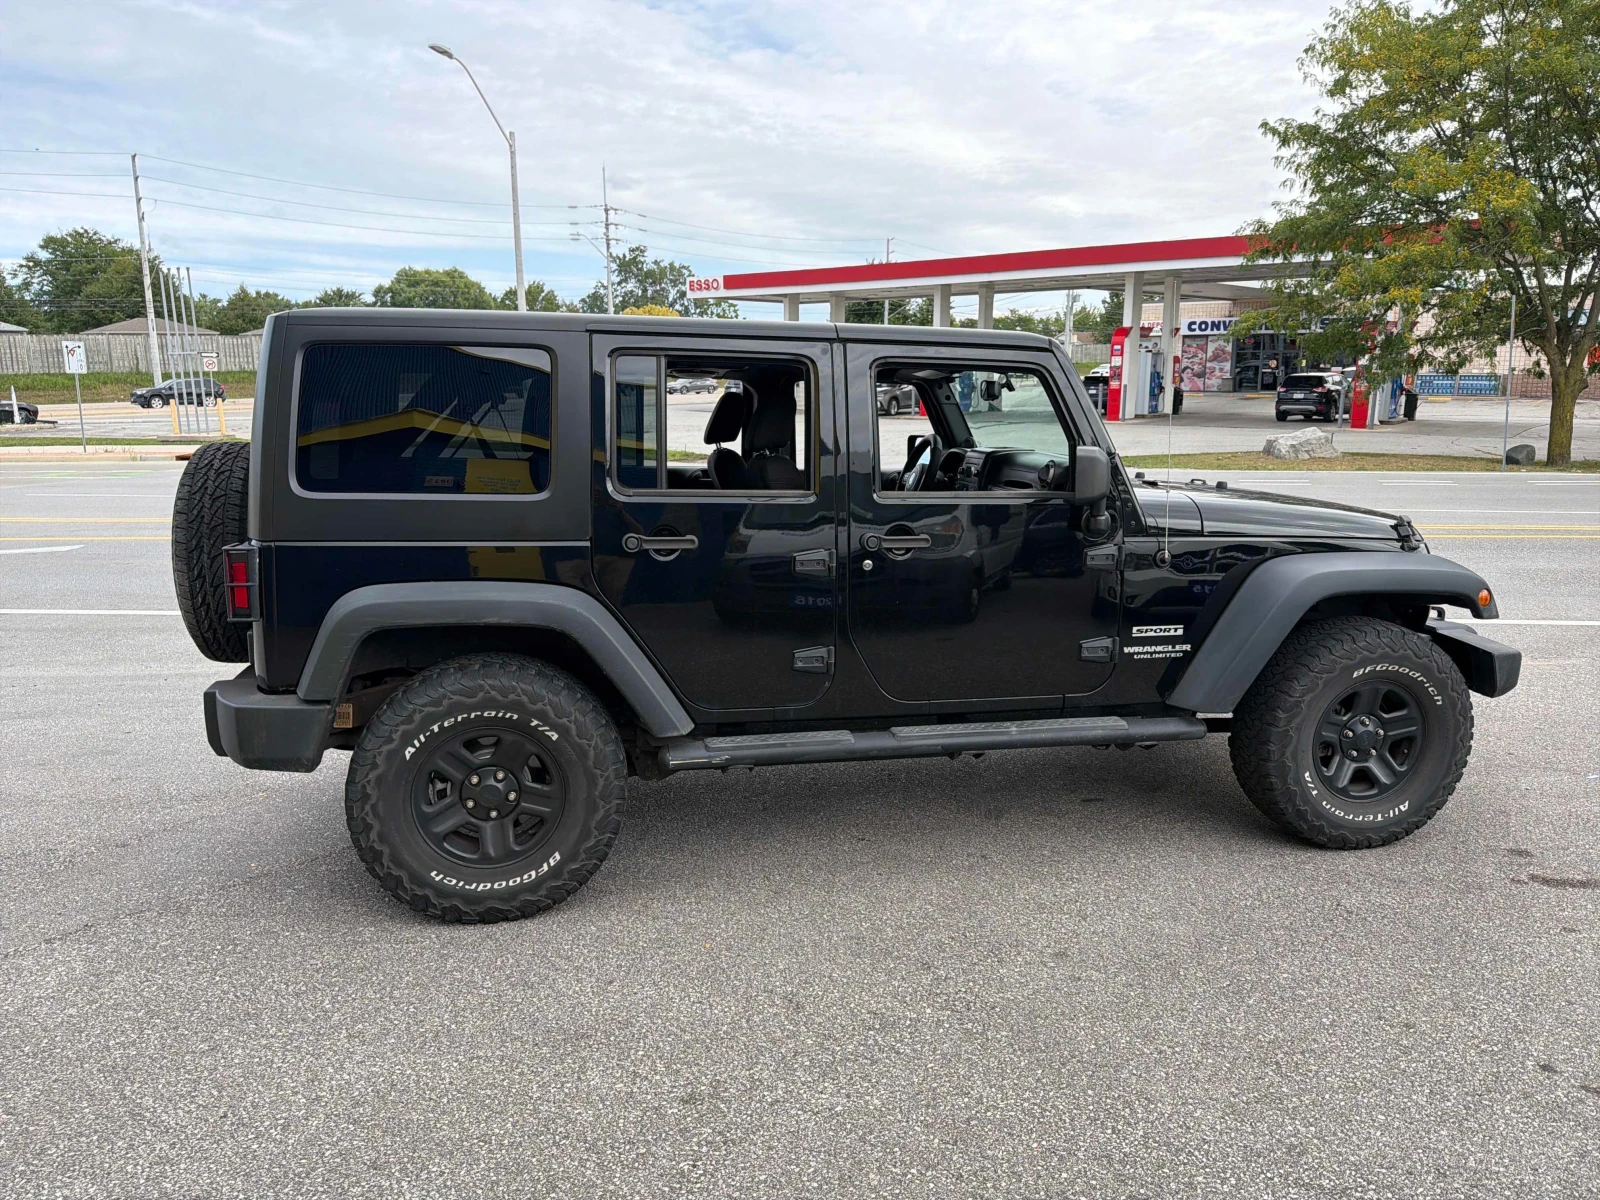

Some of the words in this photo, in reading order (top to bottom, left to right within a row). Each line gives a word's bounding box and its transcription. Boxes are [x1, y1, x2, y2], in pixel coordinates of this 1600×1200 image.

[689, 278, 720, 291] ESSO
[1134, 626, 1182, 635] SPORT
[1123, 644, 1192, 653] WRANGLER
[1352, 663, 1443, 705] BFGoodrich
[404, 710, 518, 761] All-Terrain
[529, 718, 559, 742] T/A
[1304, 771, 1318, 797] T/A
[1322, 800, 1410, 822] All-Terrain
[430, 851, 561, 892] BFGoodrich
